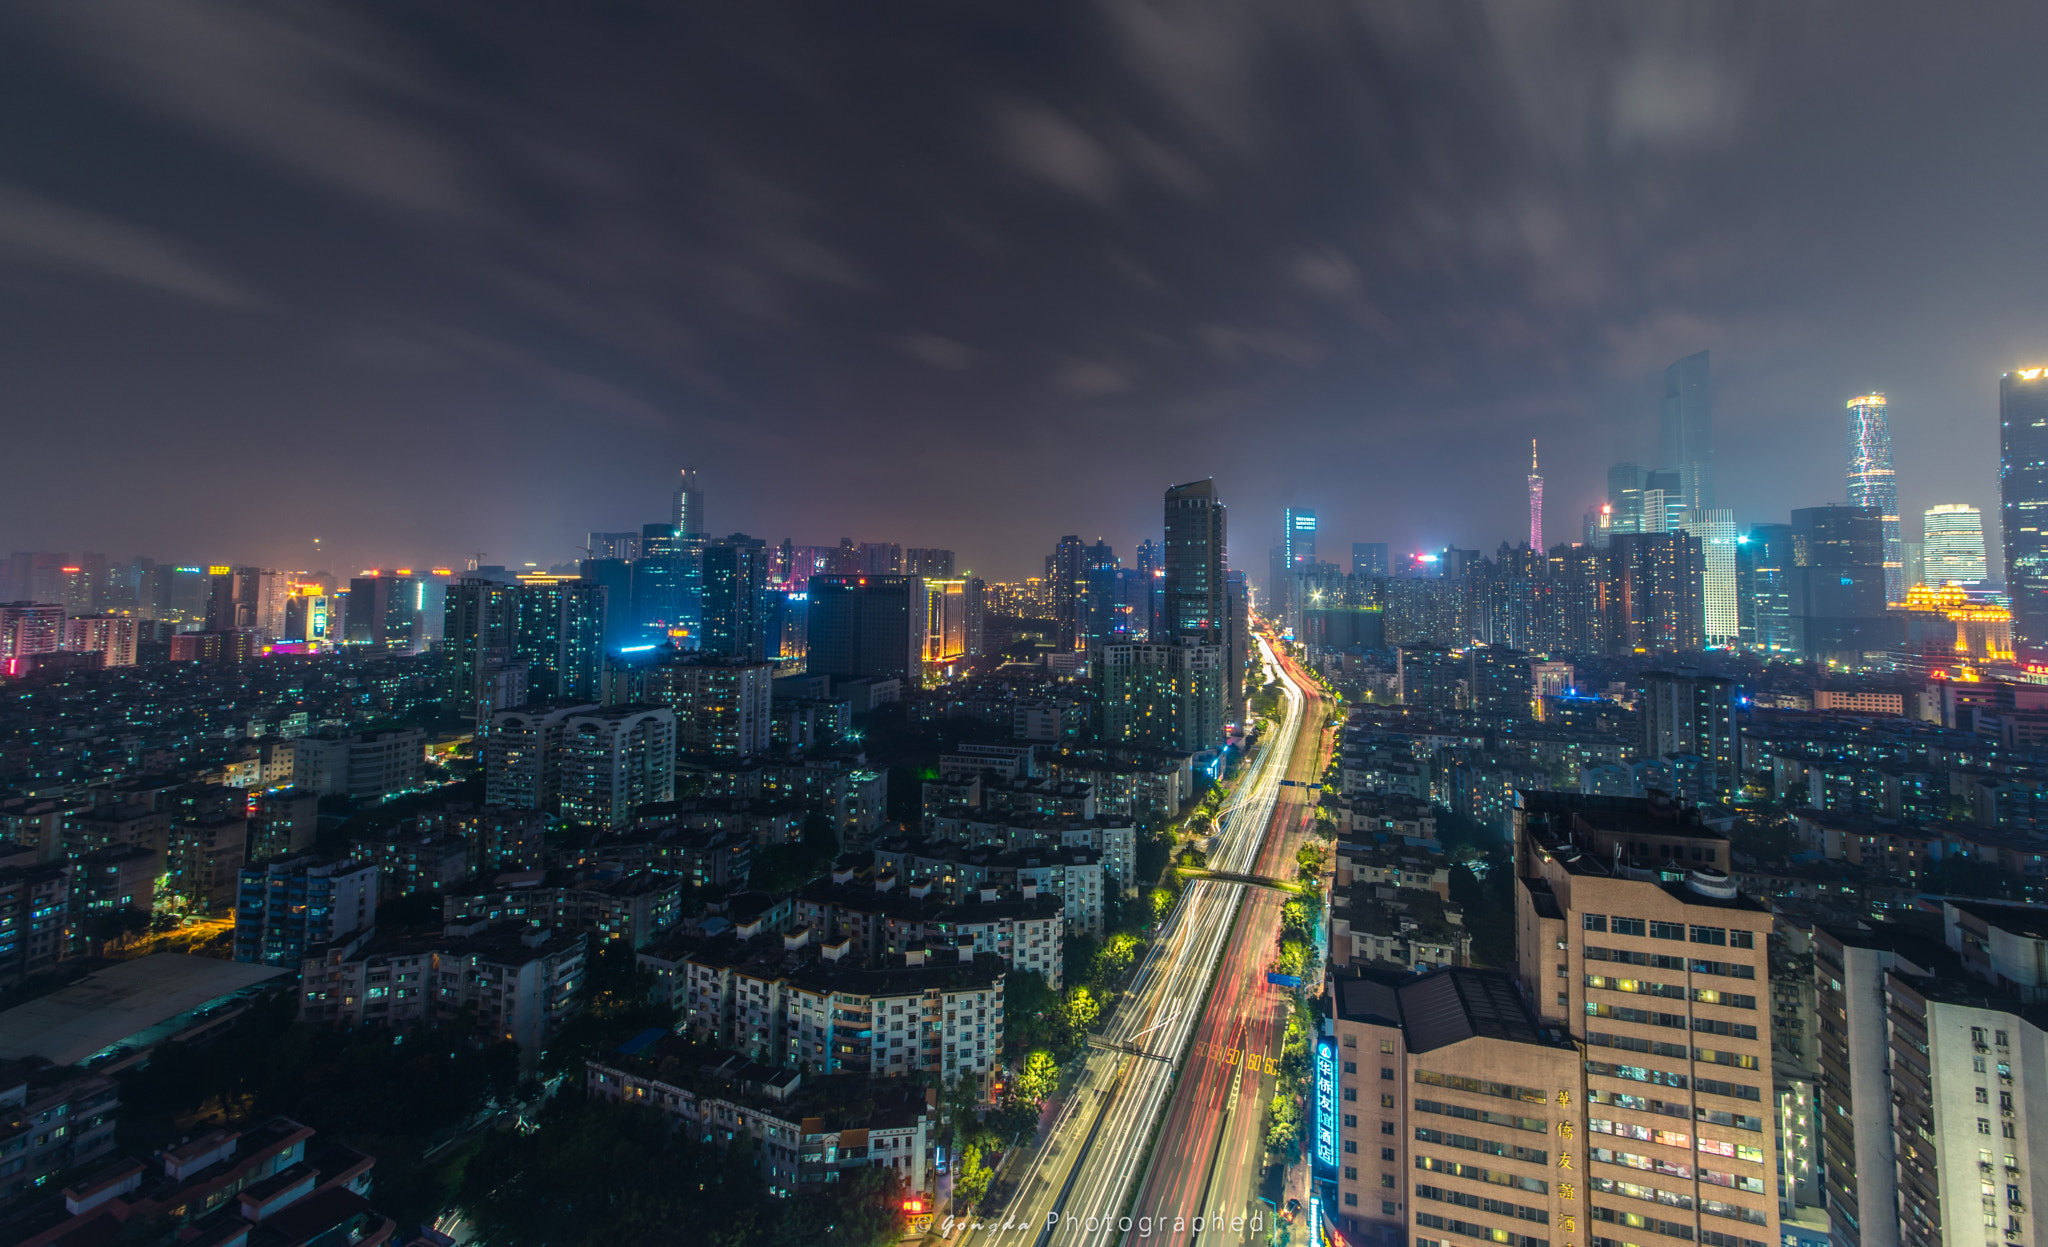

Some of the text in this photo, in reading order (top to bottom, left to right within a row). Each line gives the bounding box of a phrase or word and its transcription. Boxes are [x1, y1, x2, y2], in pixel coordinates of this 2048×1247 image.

[1226, 1048, 1240, 1065] 50
[1247, 1053, 1262, 1072] 60
[1319, 1060, 1332, 1161] 华侨友谊酒店
[1555, 1089, 1576, 1247] 華僑友誼酒
